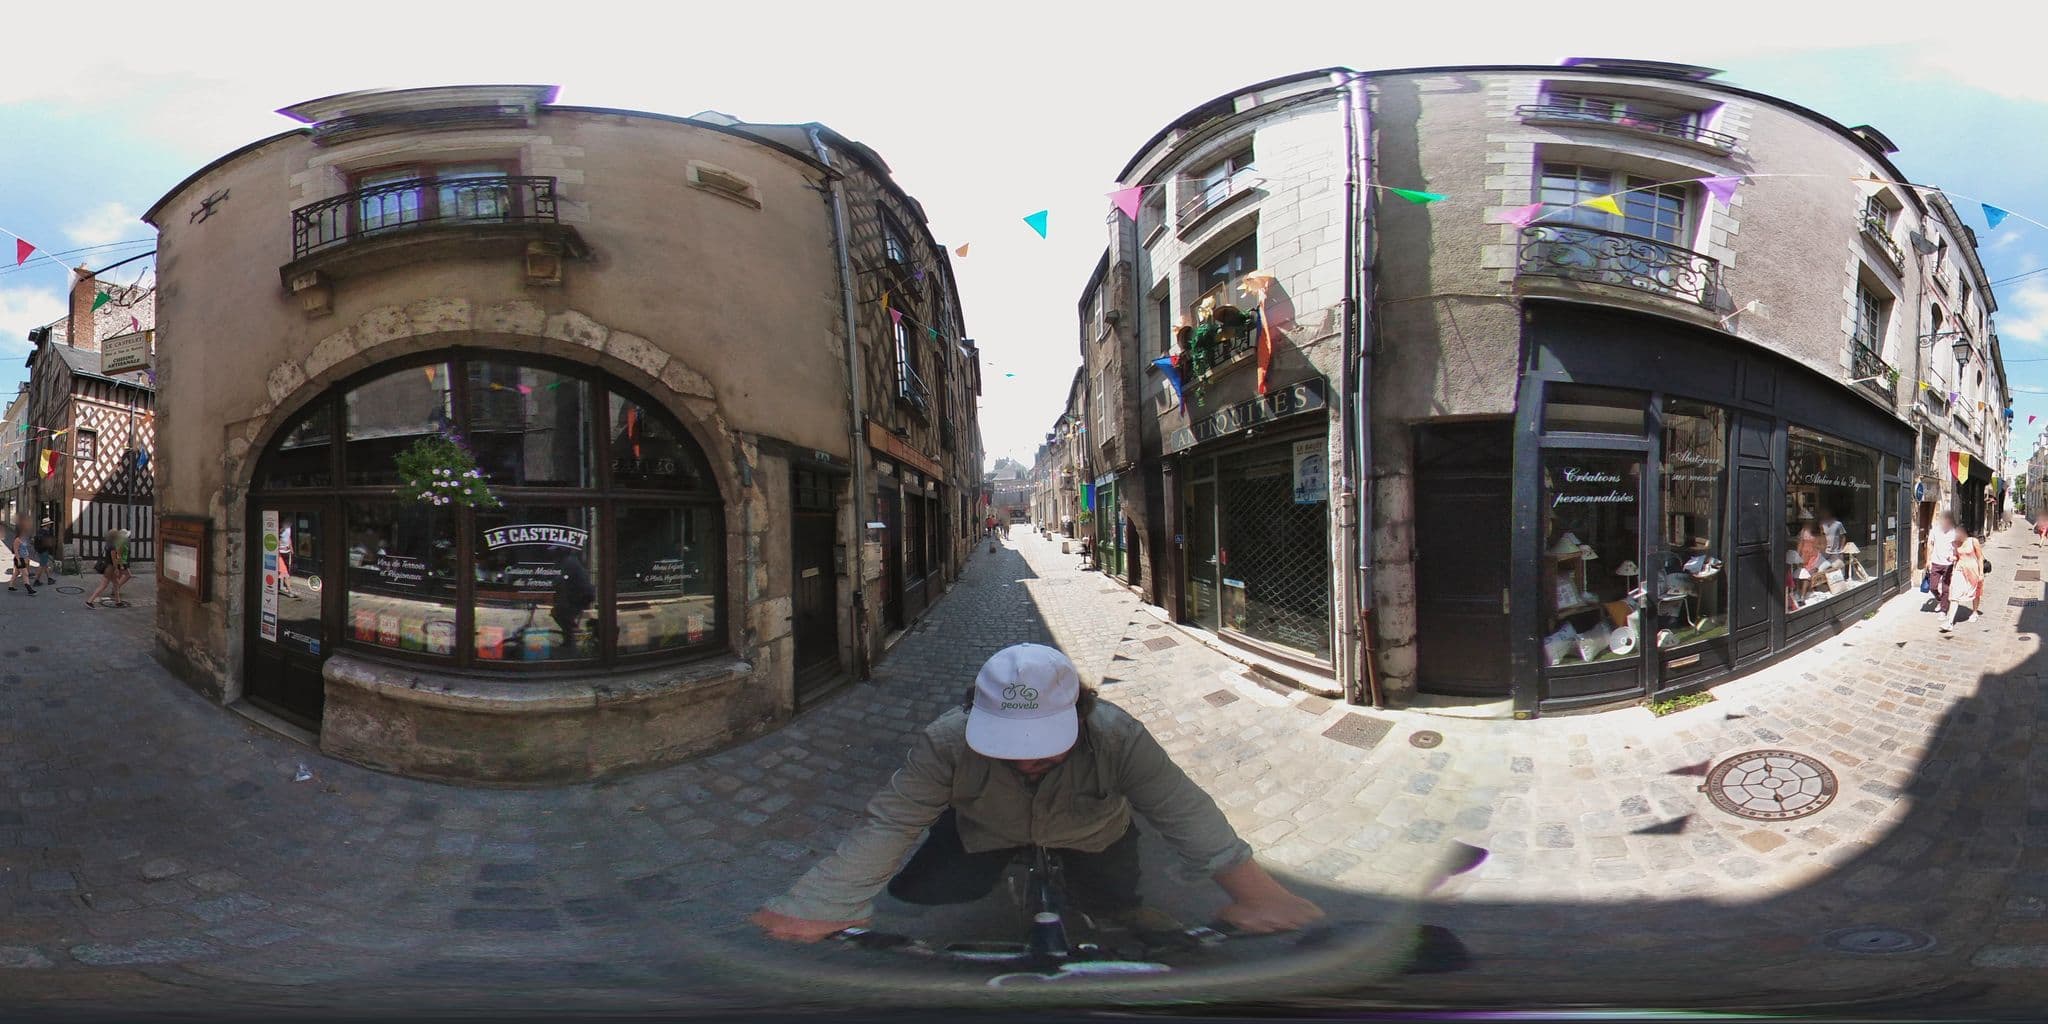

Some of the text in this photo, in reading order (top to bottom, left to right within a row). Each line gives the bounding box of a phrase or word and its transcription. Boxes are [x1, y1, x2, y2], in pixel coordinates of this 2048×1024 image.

[1564, 468, 1621, 482] Créations
[1804, 472, 1832, 484] Atelier
[1553, 490, 1634, 508] personnalisées
[485, 528, 588, 547] LE CASTELET
[504, 565, 562, 576] Cuisine Maison
[1001, 701, 1039, 711] geovelo
